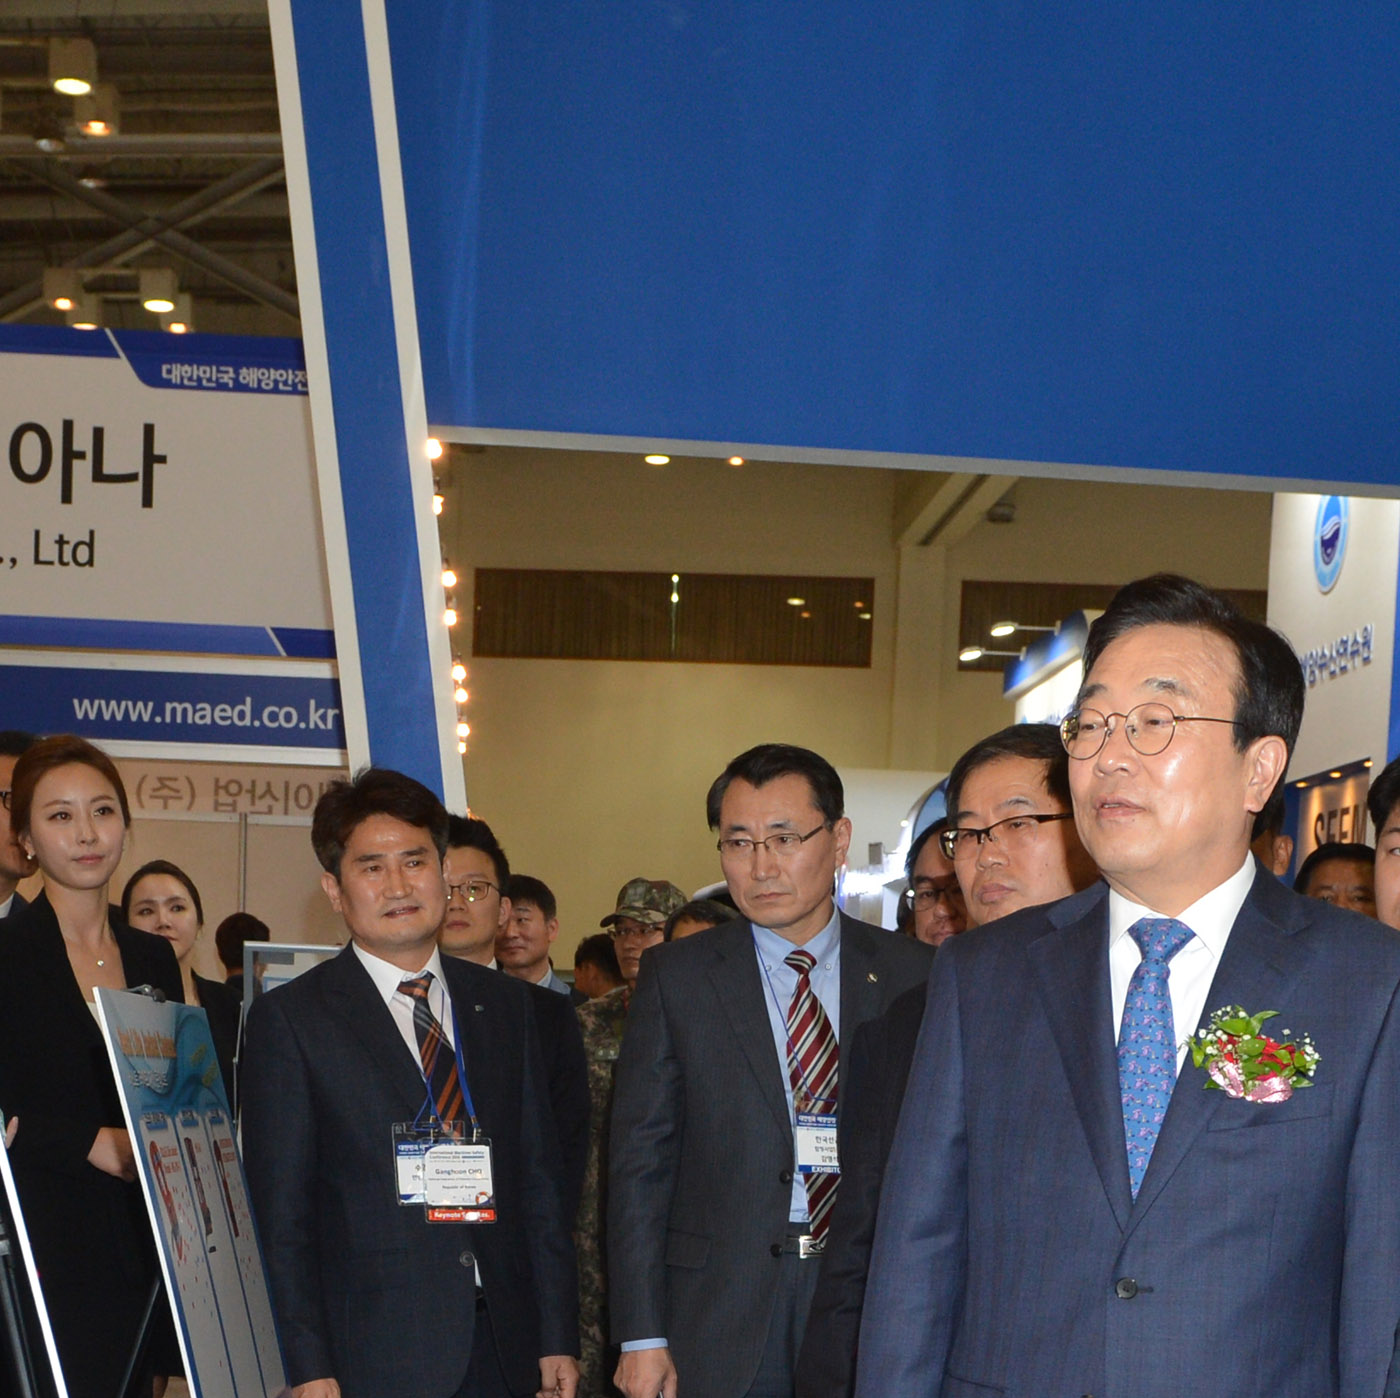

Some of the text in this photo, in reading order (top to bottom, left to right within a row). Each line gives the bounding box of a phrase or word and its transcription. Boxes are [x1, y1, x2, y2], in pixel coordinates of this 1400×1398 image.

[162, 363, 235, 388] 대한민국
[33, 529, 95, 568] Ltd
[73, 695, 340, 731] www.maed.co.kr
